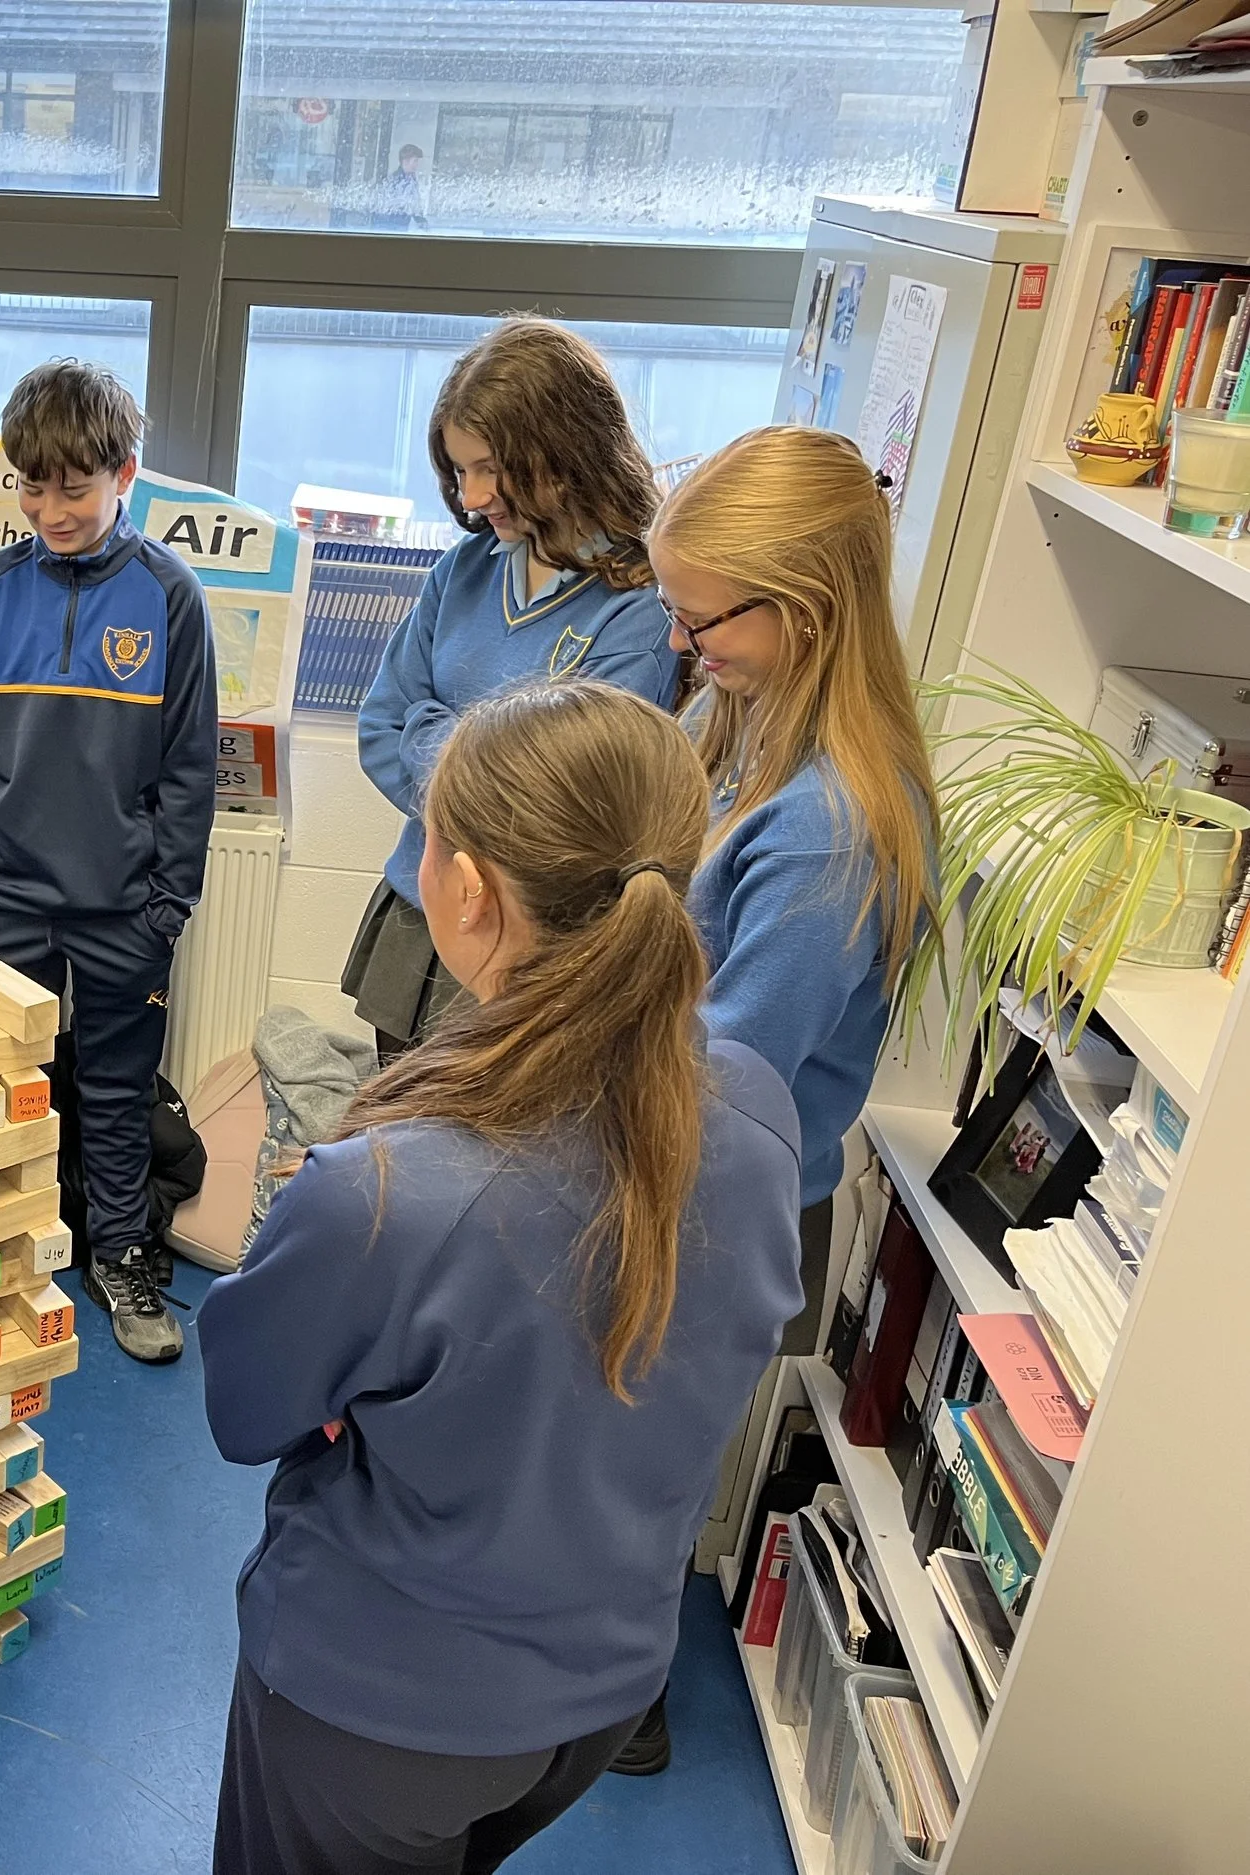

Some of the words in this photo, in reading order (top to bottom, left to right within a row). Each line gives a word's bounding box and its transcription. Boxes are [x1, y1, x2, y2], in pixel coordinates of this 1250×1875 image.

[1139, 290, 1169, 381] HARRAP'S
[161, 515, 258, 558] Air
[6, 1581, 30, 1601] Land
